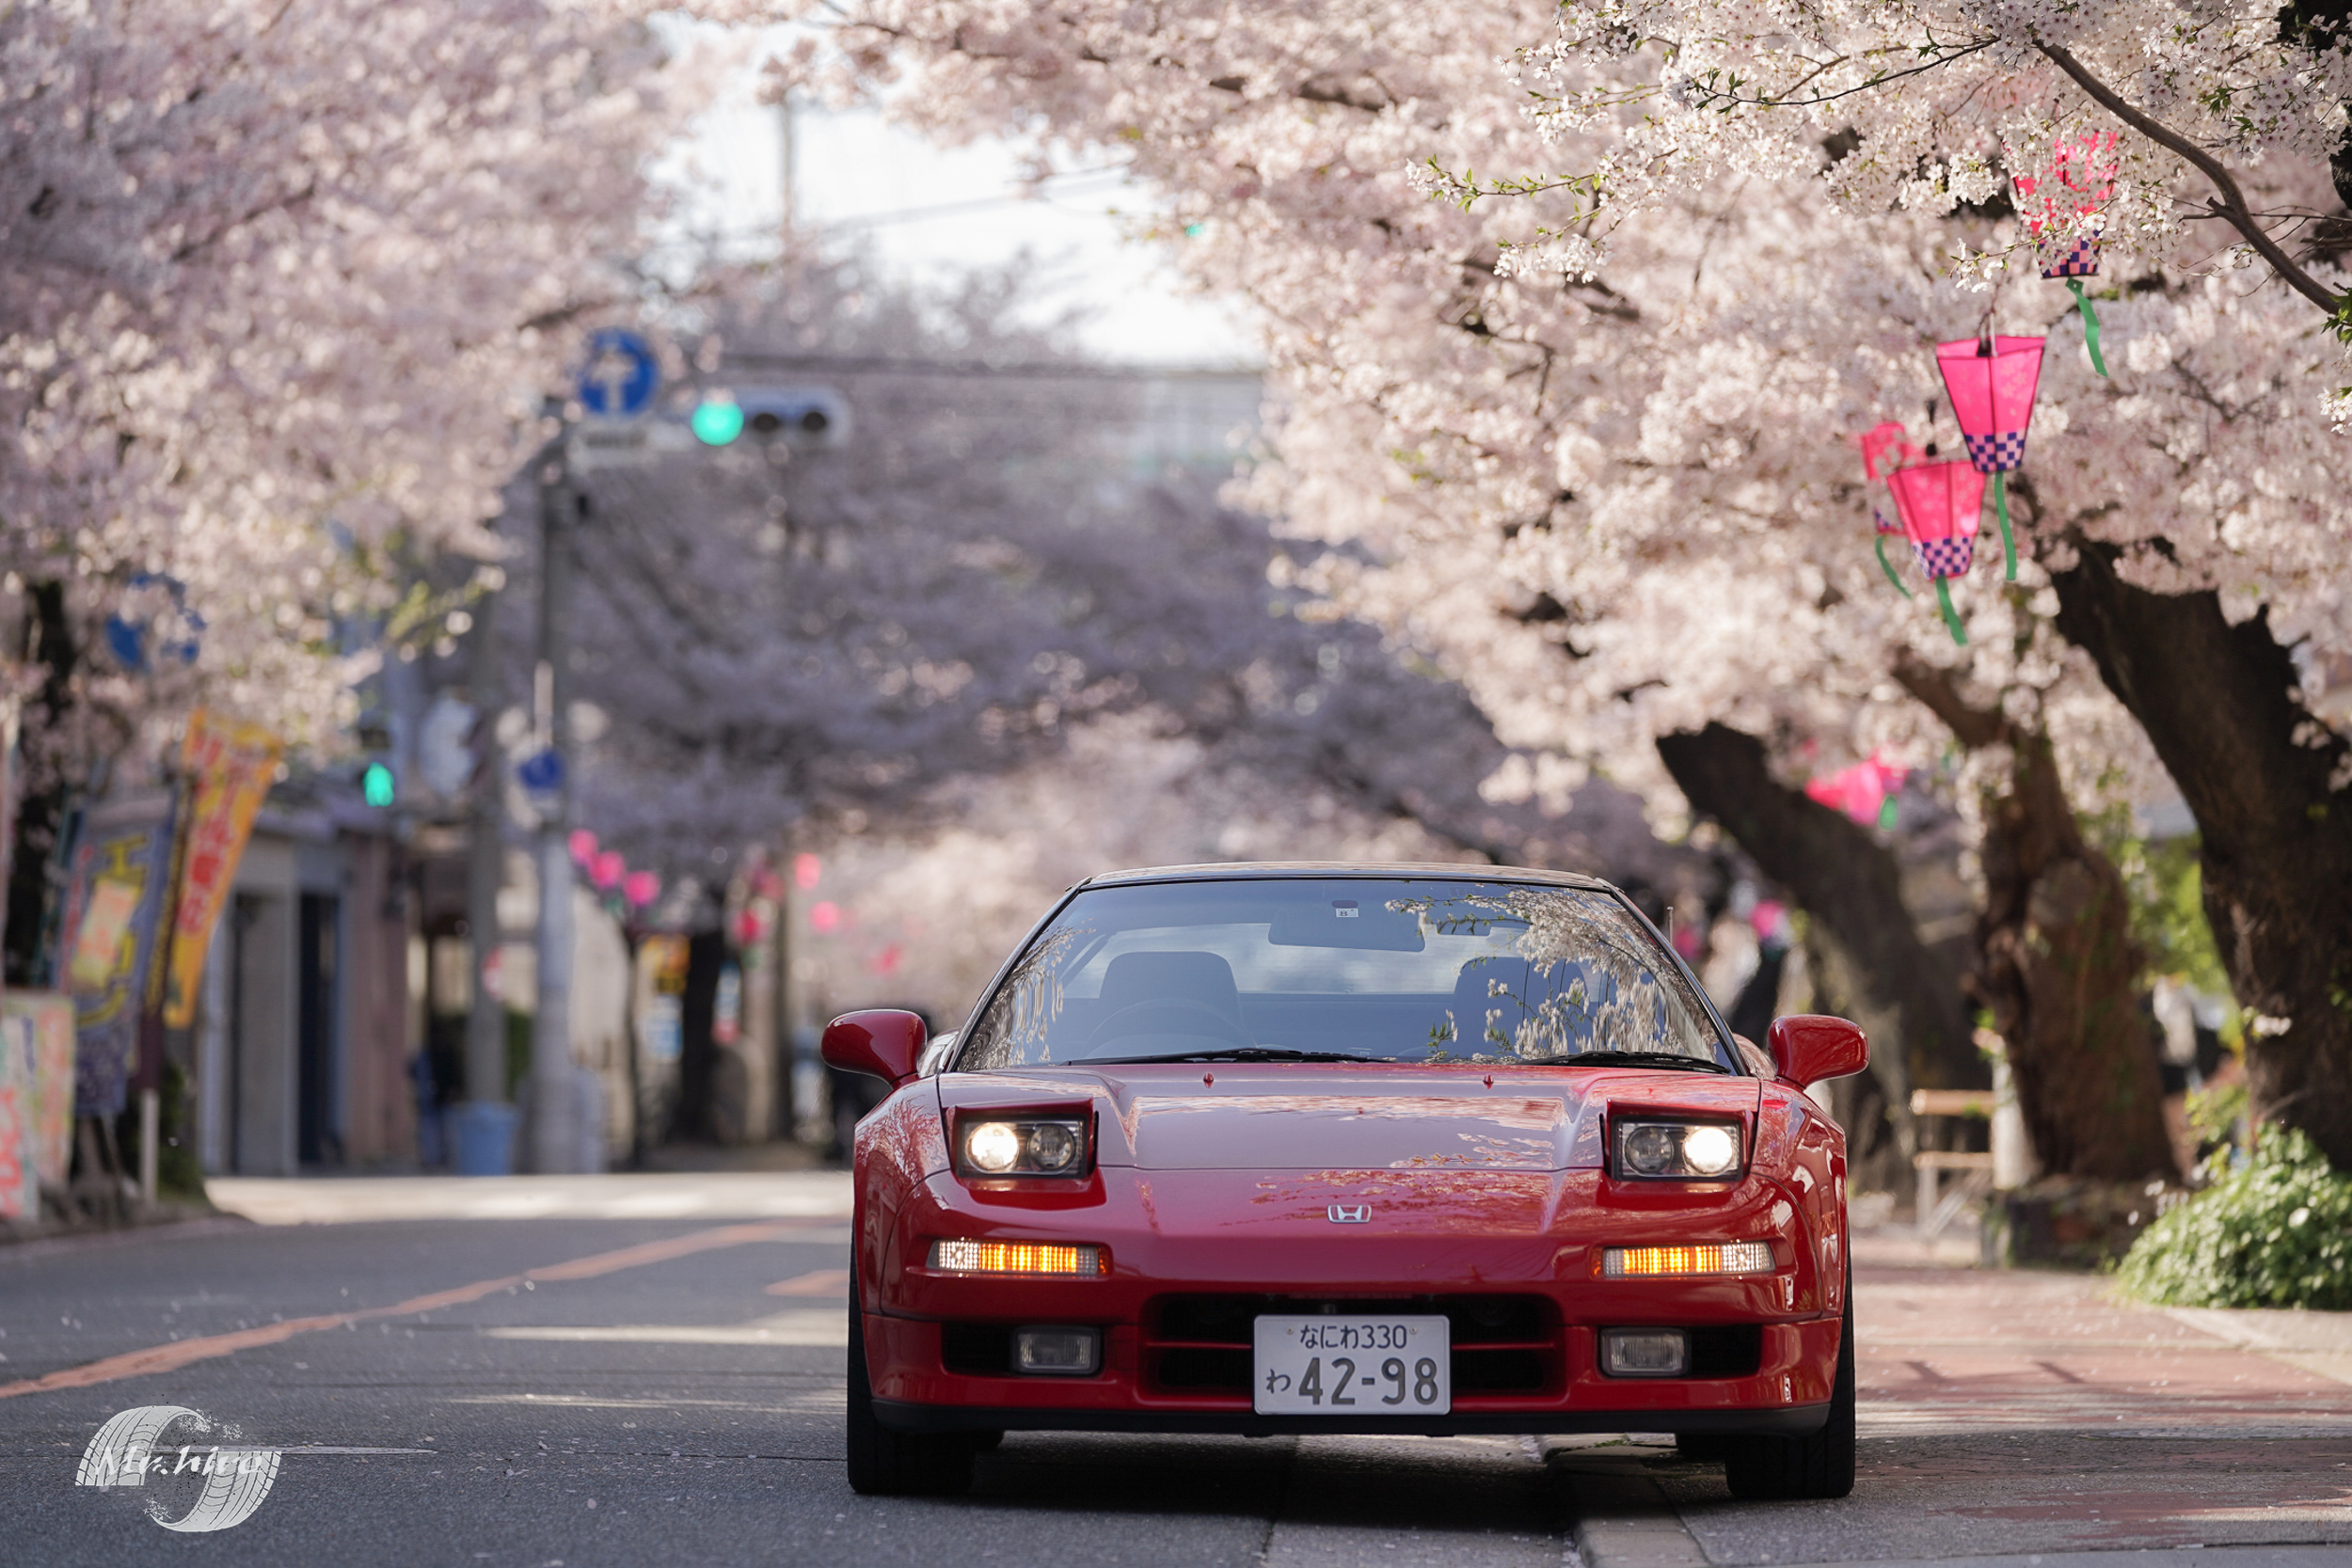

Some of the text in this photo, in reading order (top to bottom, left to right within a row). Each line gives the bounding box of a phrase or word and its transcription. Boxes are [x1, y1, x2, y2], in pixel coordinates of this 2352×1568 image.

[1300, 1324, 1407, 1349] なにわ330
[1266, 1357, 1438, 1405] わ 42-98
